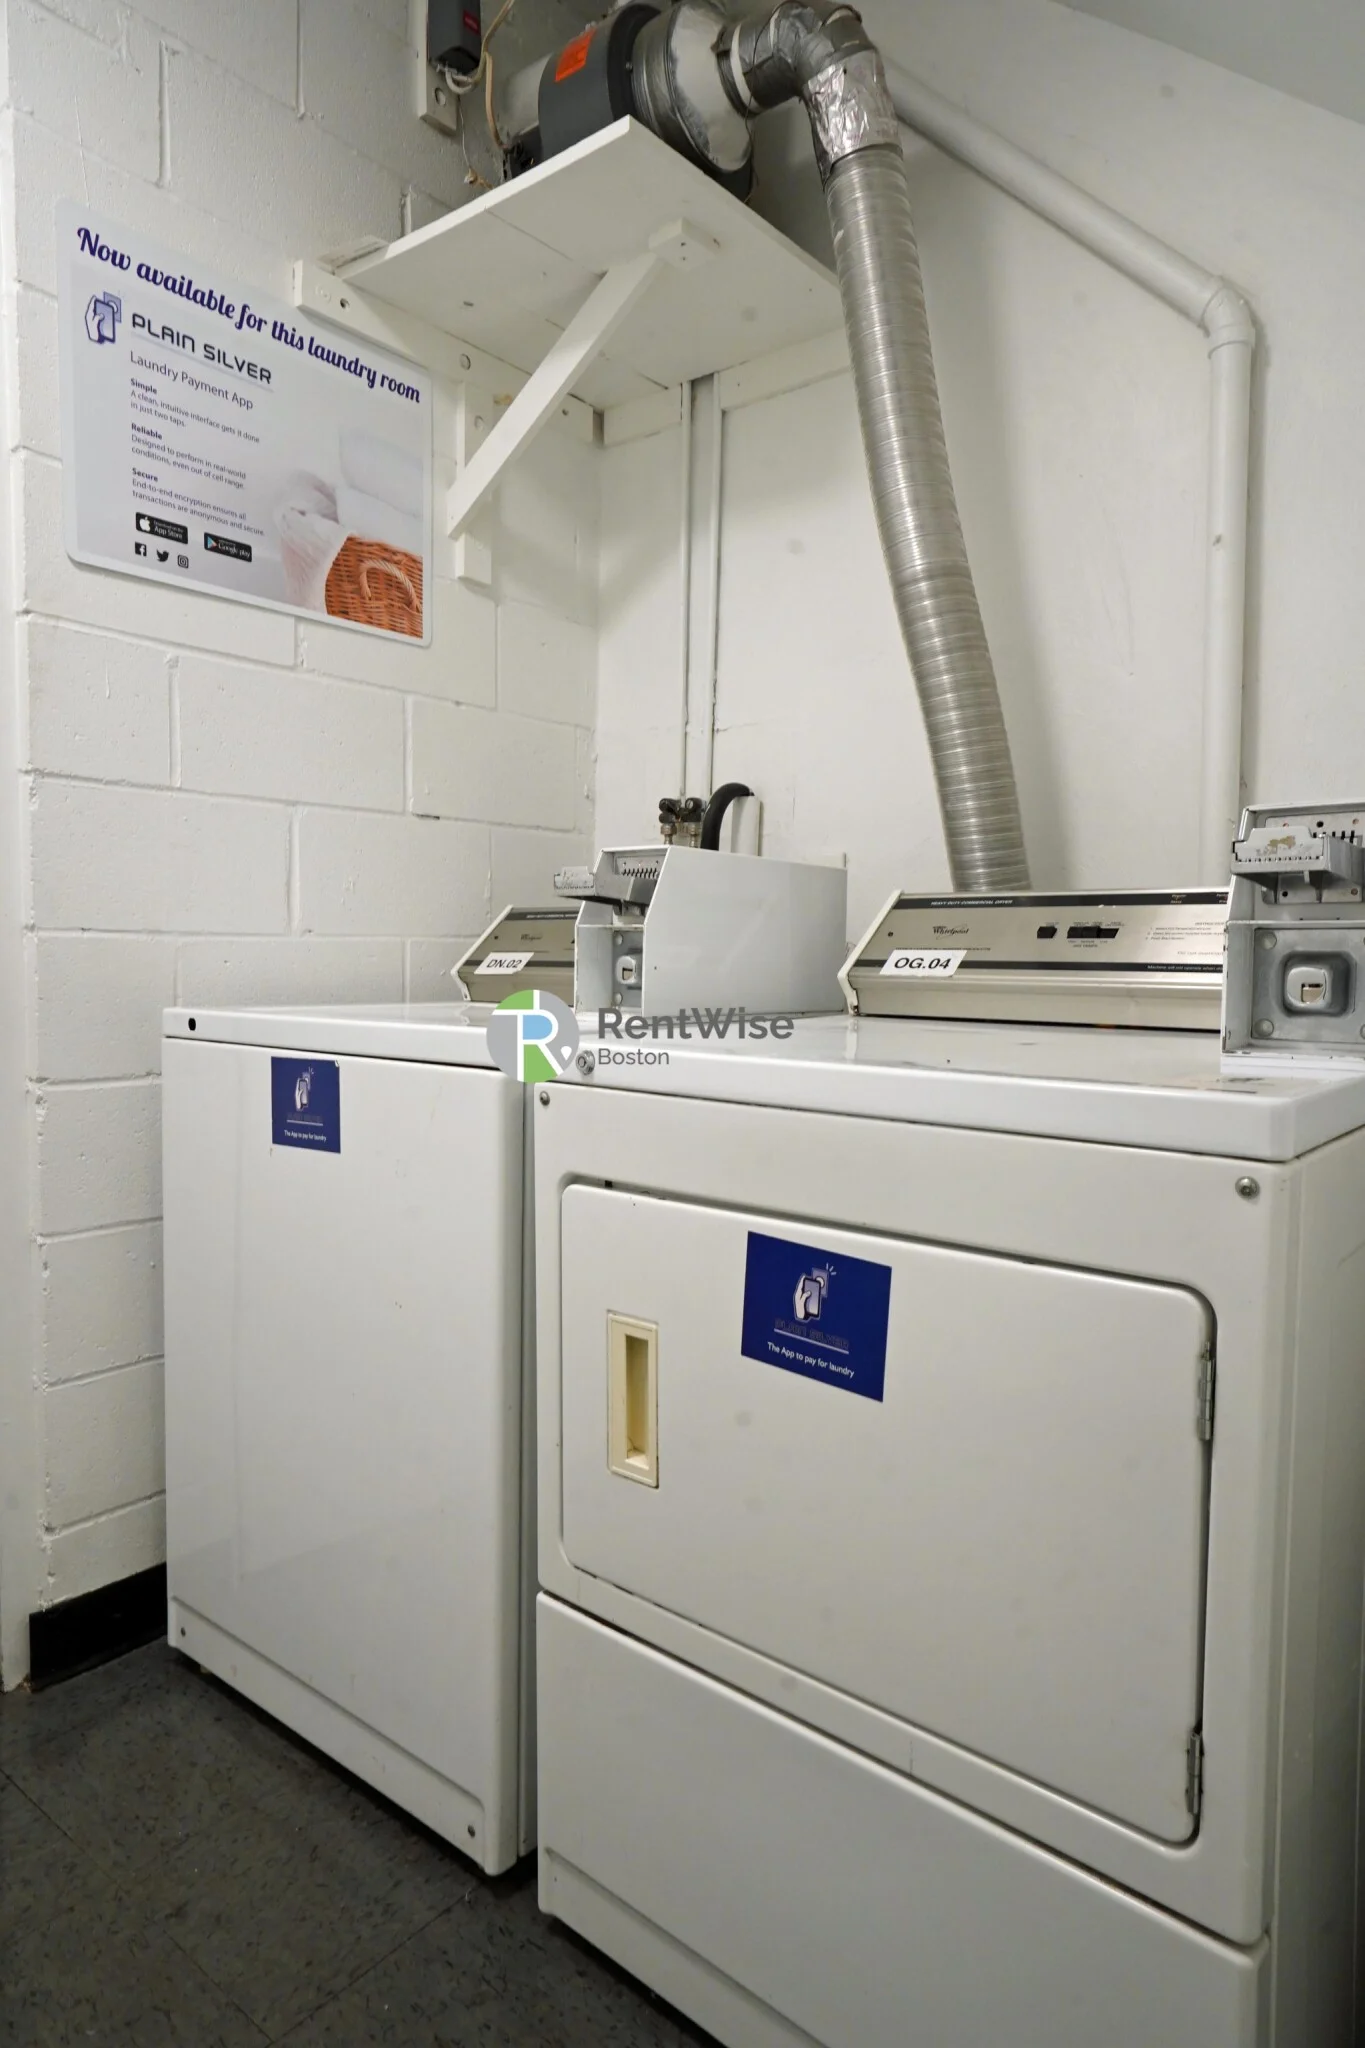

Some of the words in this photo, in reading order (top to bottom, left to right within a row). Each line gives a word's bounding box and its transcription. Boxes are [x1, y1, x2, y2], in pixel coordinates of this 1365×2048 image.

[77, 227, 131, 271] Now
[136, 262, 236, 319] available
[235, 304, 268, 332] for
[271, 320, 304, 351] this
[307, 336, 377, 389] laundry
[379, 373, 420, 404] room
[132, 312, 195, 353] PLAIN
[203, 343, 272, 385] SILVER
[130, 350, 179, 382] Laundry
[181, 371, 229, 400] Payment
[231, 392, 254, 411] App
[130, 378, 158, 395] Simple
[130, 390, 136, 398] A
[138, 391, 159, 408] clean,
[160, 401, 189, 418] intuitive
[190, 412, 220, 429] interface
[221, 424, 236, 436] gets
[237, 428, 243, 438] it
[243, 432, 260, 443] done
[131, 401, 138, 410] in
[139, 403, 153, 415] just
[155, 410, 169, 421] two
[170, 416, 187, 429] taps.
[131, 422, 163, 441] Reliable
[131, 434, 166, 453] Designed
[167, 446, 175, 456] to
[176, 450, 204, 467] perform
[205, 459, 212, 468] in
[213, 462, 247, 480] real-world
[131, 446, 172, 467] conditions,
[172, 460, 190, 472] even
[190, 466, 203, 476] out
[203, 470, 212, 479] of
[212, 472, 224, 484] cell
[224, 479, 245, 491] range.
[132, 467, 159, 482] Secure
[132, 478, 173, 498] End-to-end
[174, 491, 212, 511] encryption
[212, 505, 238, 518] ensures
[238, 512, 247, 521] all
[132, 489, 176, 510] transactions
[177, 504, 189, 514] are
[190, 508, 229, 526] anonymous
[229, 519, 243, 530] and
[154, 525, 167, 537] App
[168, 529, 183, 540] Store
[486, 959, 523, 969] DN.02
[893, 957, 952, 970] OG.04
[767, 1341, 780, 1354] The
[781, 1347, 795, 1360] App
[795, 1351, 804, 1361] to
[804, 1355, 817, 1368] pay
[817, 1357, 828, 1369] for
[829, 1361, 855, 1379] laundry
